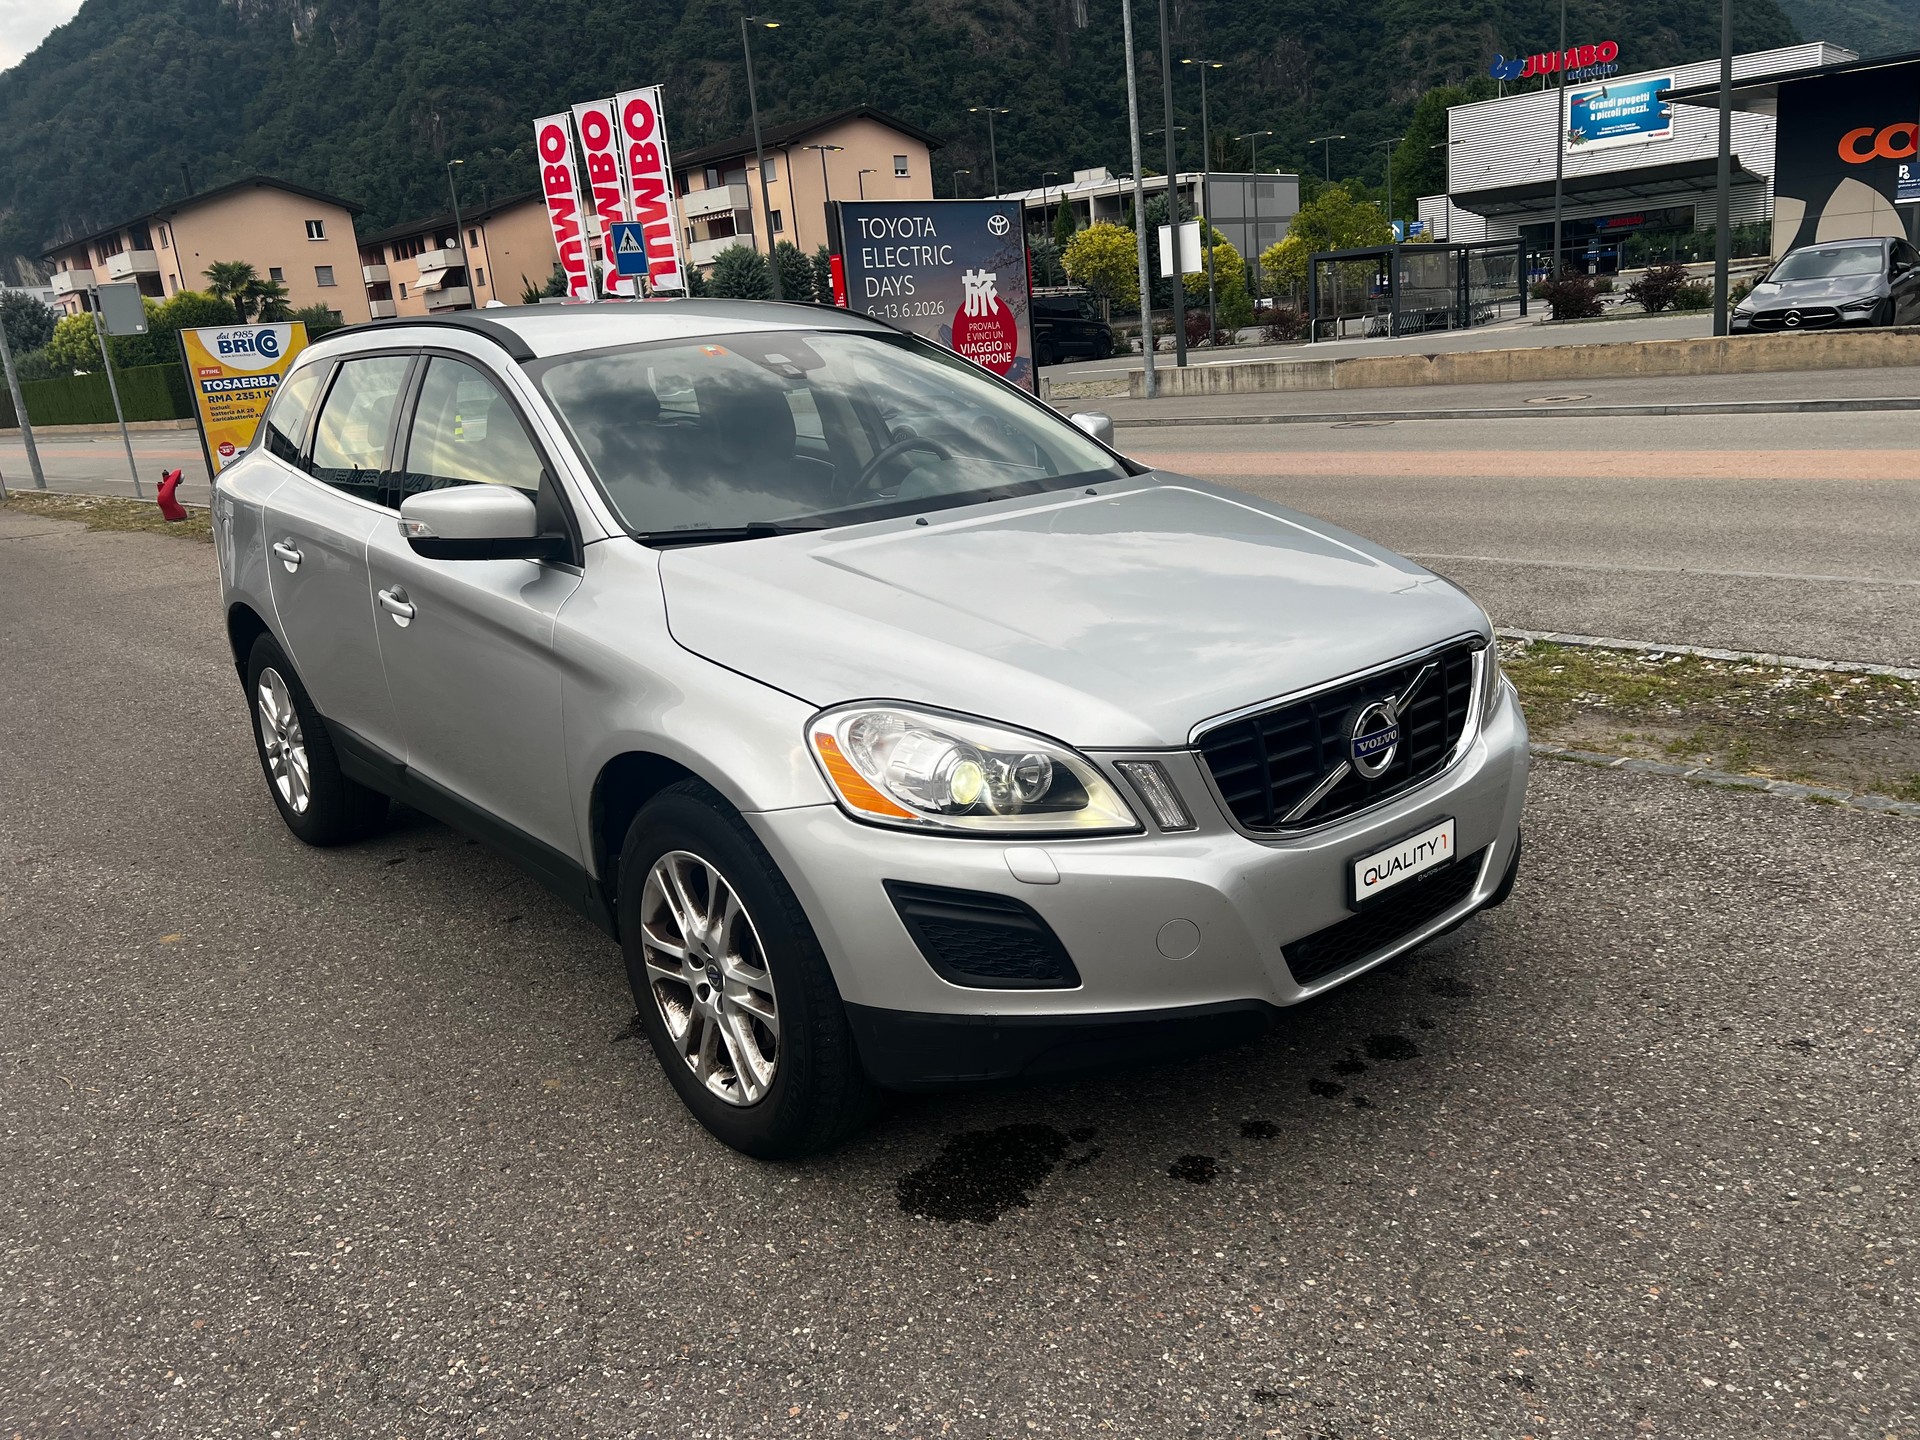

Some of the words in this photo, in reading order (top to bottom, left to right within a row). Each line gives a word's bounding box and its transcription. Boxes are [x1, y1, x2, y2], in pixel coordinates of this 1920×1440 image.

[1523, 41, 1618, 77] JUMBO
[1589, 97, 1616, 110] Grandi
[1617, 91, 1650, 107] progetti
[1590, 113, 1596, 121] a
[1596, 107, 1621, 121] piccoli
[1622, 102, 1650, 117] prezzi.
[624, 99, 677, 286] JUMBO
[540, 124, 588, 296] JUMBO
[858, 217, 937, 239] TOYOTA
[862, 245, 953, 269] ELECTRIC
[865, 275, 915, 298] DAYS
[962, 269, 999, 318] 旅
[216, 332, 229, 340] dal
[232, 330, 254, 339] 1985
[969, 321, 1001, 331] PROVALA
[217, 329, 280, 358] BRICO
[966, 333, 971, 342] E
[973, 331, 992, 341] VINCI
[993, 330, 1004, 339] UN
[960, 341, 1003, 355] VIAGGIO
[1004, 342, 1012, 350] IN
[966, 352, 1012, 365] IAPPONE
[203, 375, 278, 391] TOSAERBA
[207, 394, 234, 404] RMA
[235, 391, 262, 401] 235.1
[212, 413, 254, 423] caricabatterie
[1357, 729, 1397, 752] VOLVO
